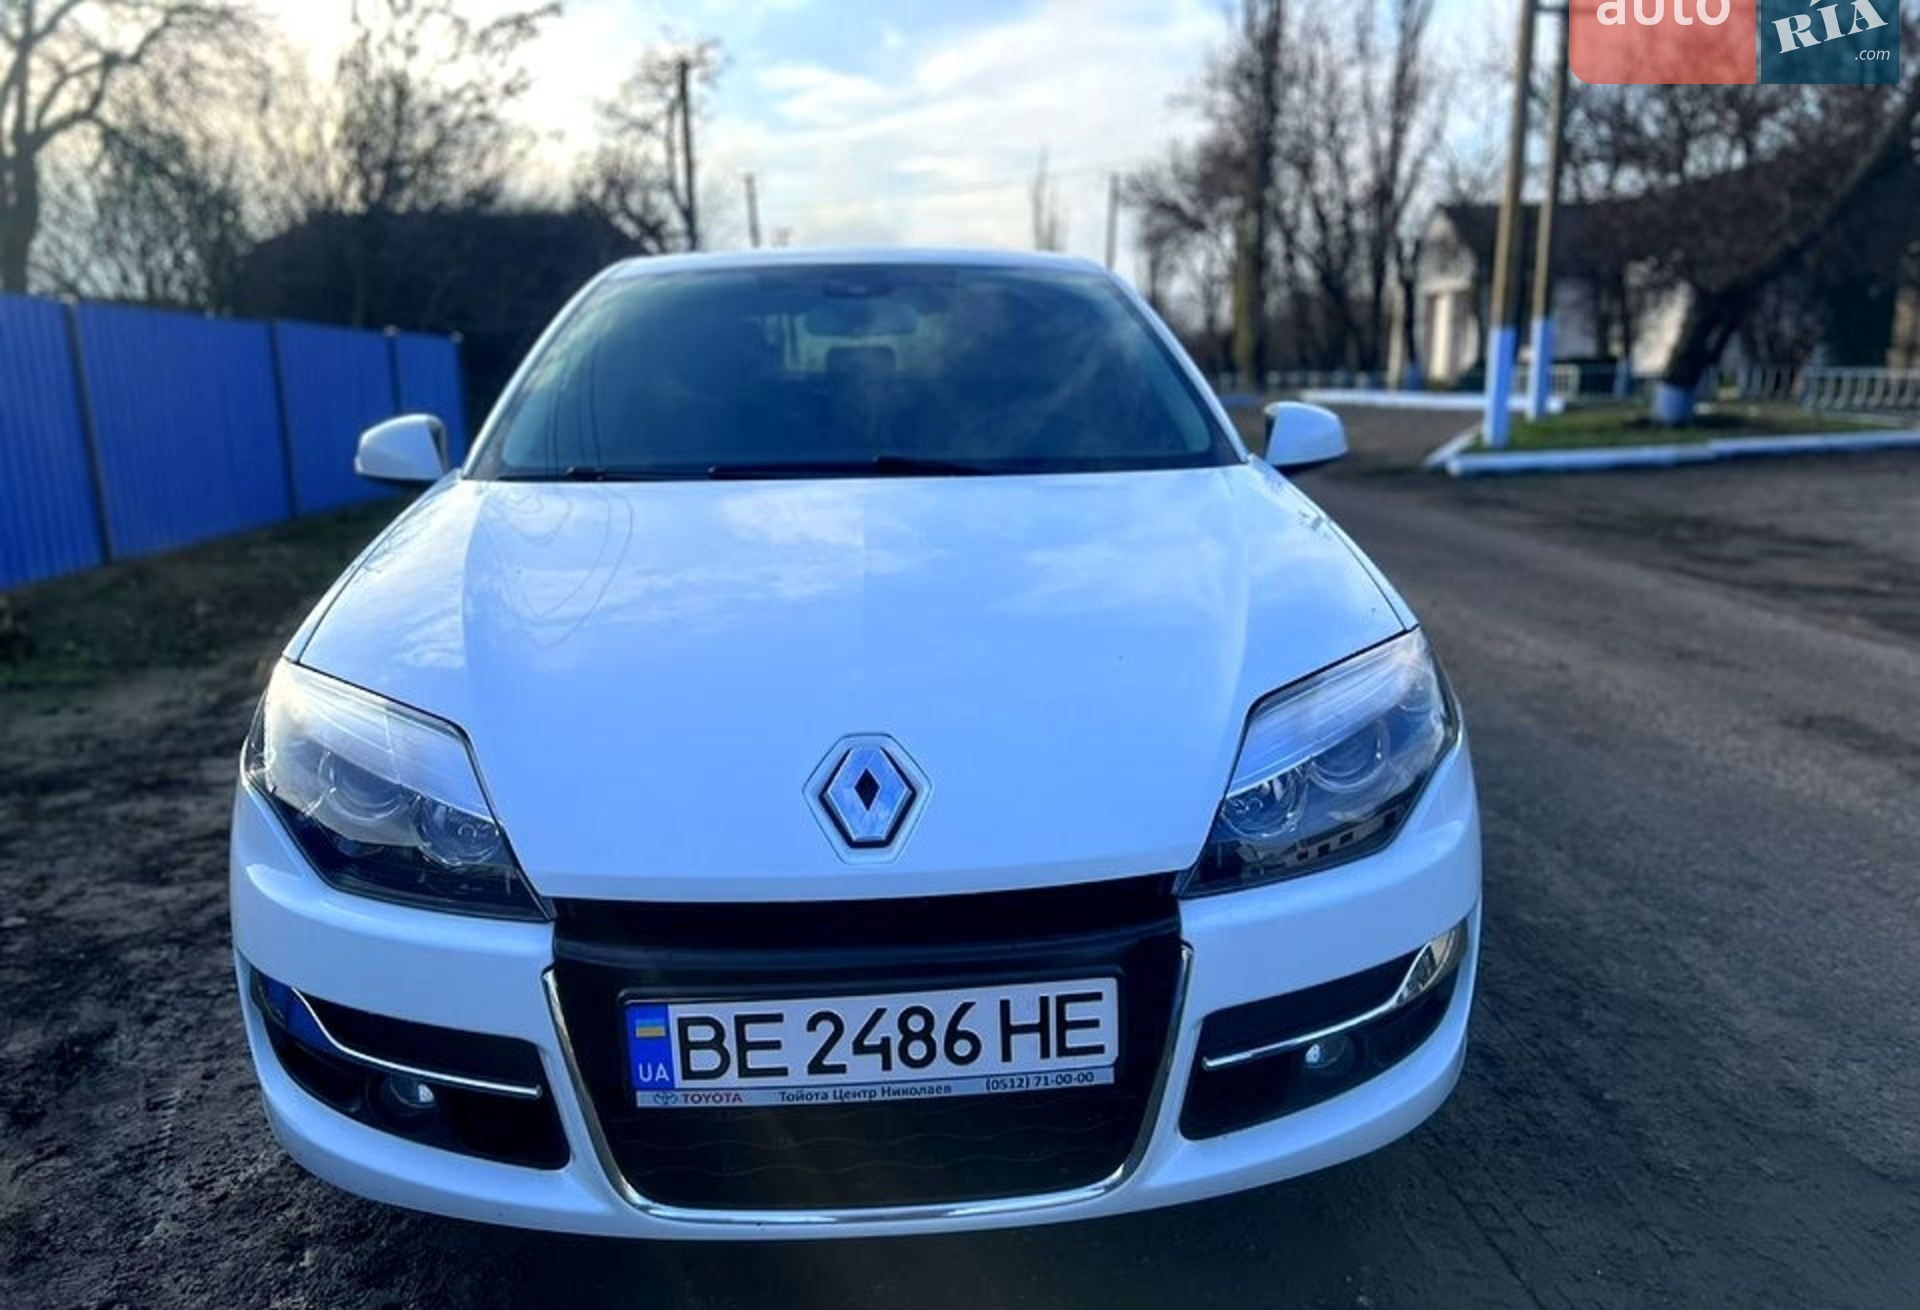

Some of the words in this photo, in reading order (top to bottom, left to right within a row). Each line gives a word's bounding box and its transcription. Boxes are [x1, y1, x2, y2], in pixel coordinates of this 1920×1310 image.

[677, 1013, 789, 1081] BE
[805, 1001, 982, 1075] 2486
[999, 991, 1105, 1063] HE
[638, 1063, 669, 1083] UA
[985, 1075, 1031, 1093] (0512)
[1034, 1071, 1094, 1087] 71-00-00
[682, 1092, 743, 1104] TOYOTA
[779, 1089, 830, 1102] Тойота
[832, 1087, 878, 1102] Центр
[881, 1083, 951, 1099] Николаев
